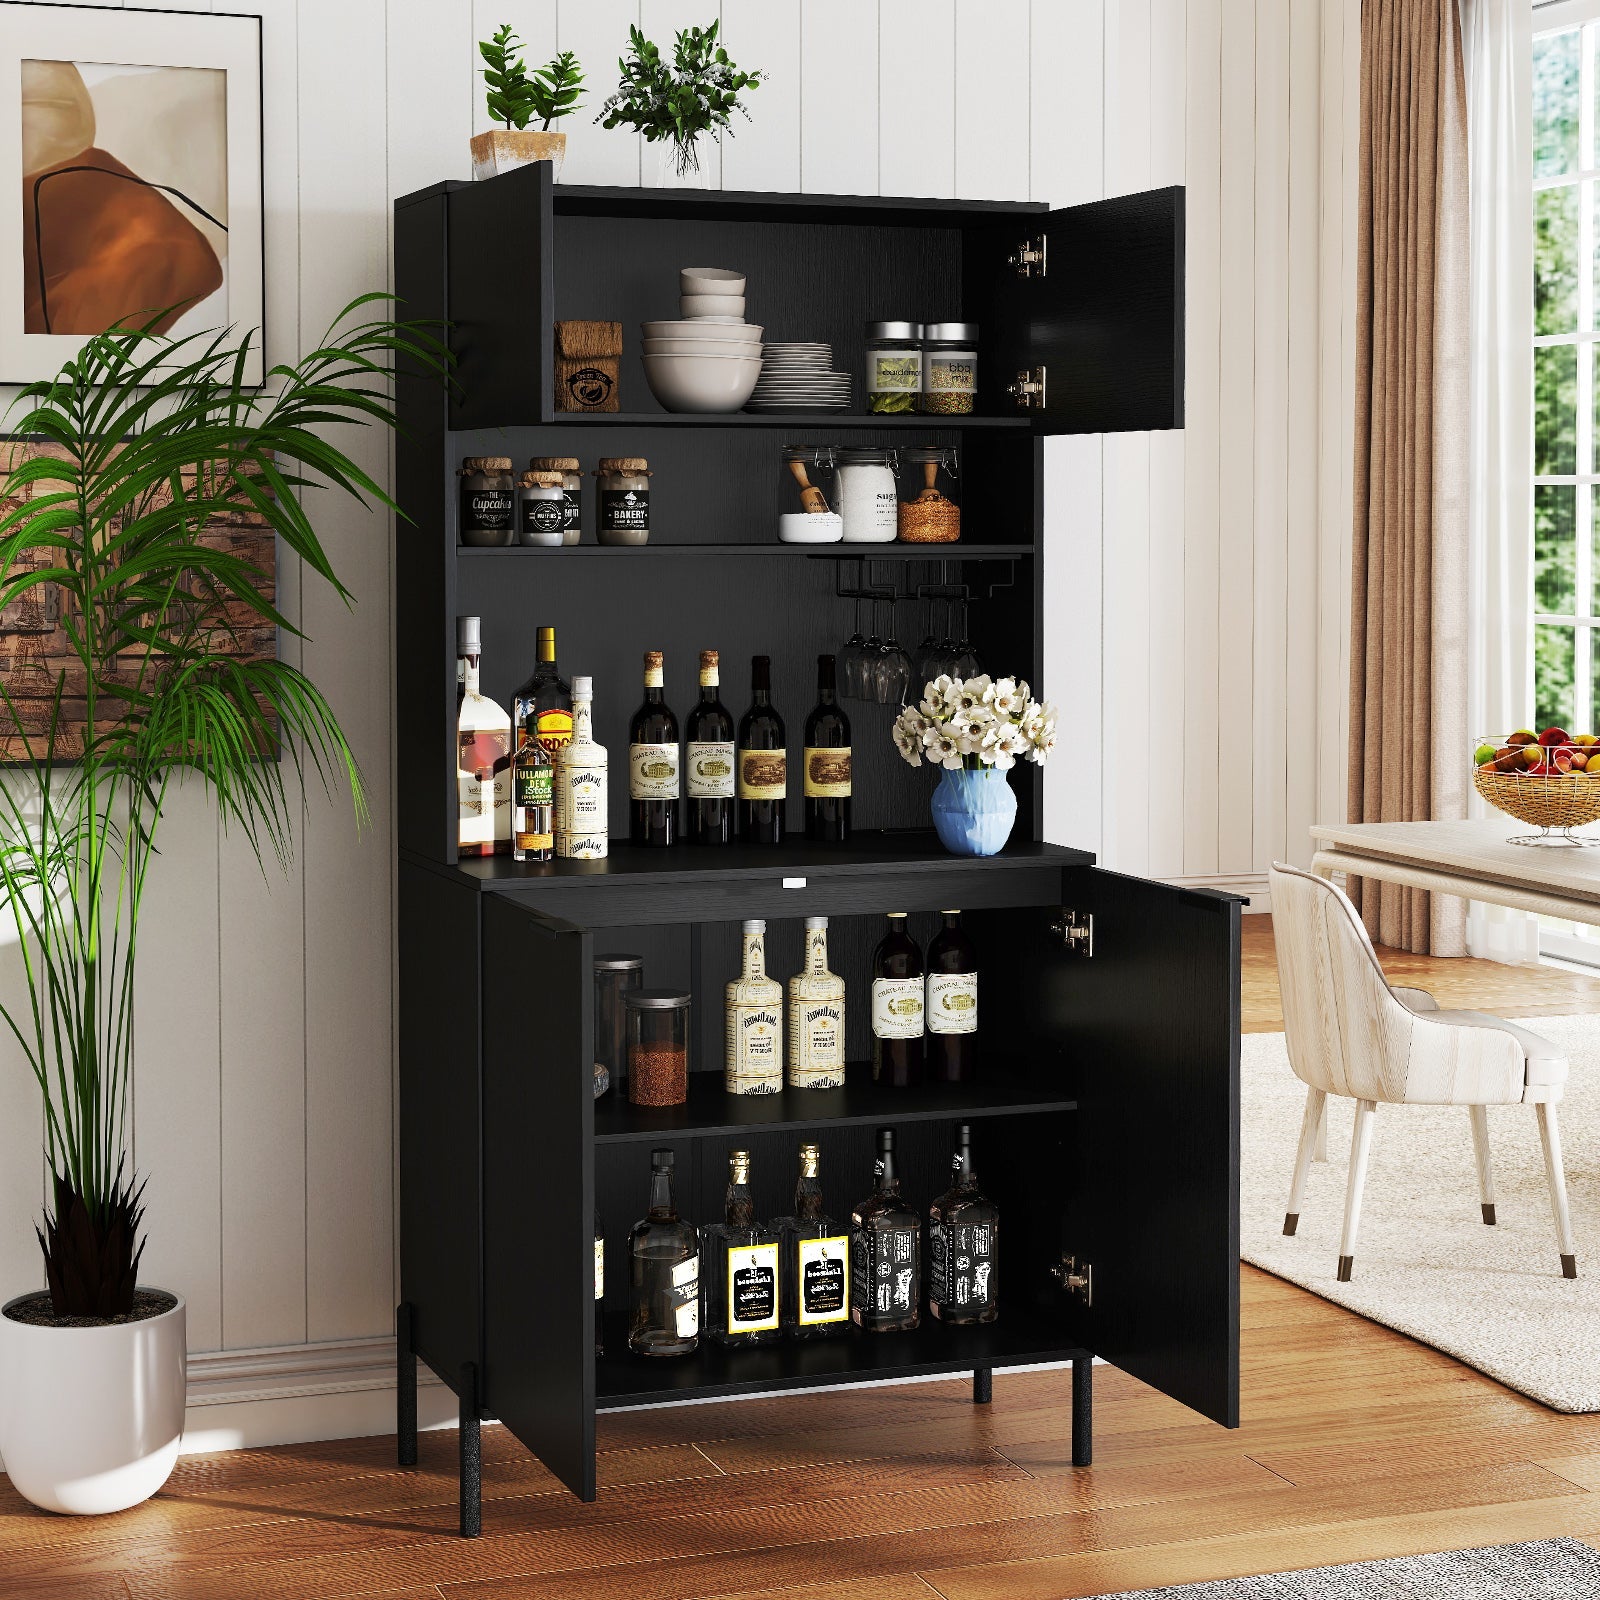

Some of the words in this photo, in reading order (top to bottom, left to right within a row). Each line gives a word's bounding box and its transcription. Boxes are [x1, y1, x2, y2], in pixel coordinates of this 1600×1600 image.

[949, 363, 971, 374] bbq
[489, 491, 499, 499] THE
[876, 493, 897, 503] sug
[472, 497, 512, 512] Cupcakes
[613, 510, 645, 519] BAKERY
[516, 768, 554, 780] TULLAMOR
[525, 785, 552, 794] iStock
